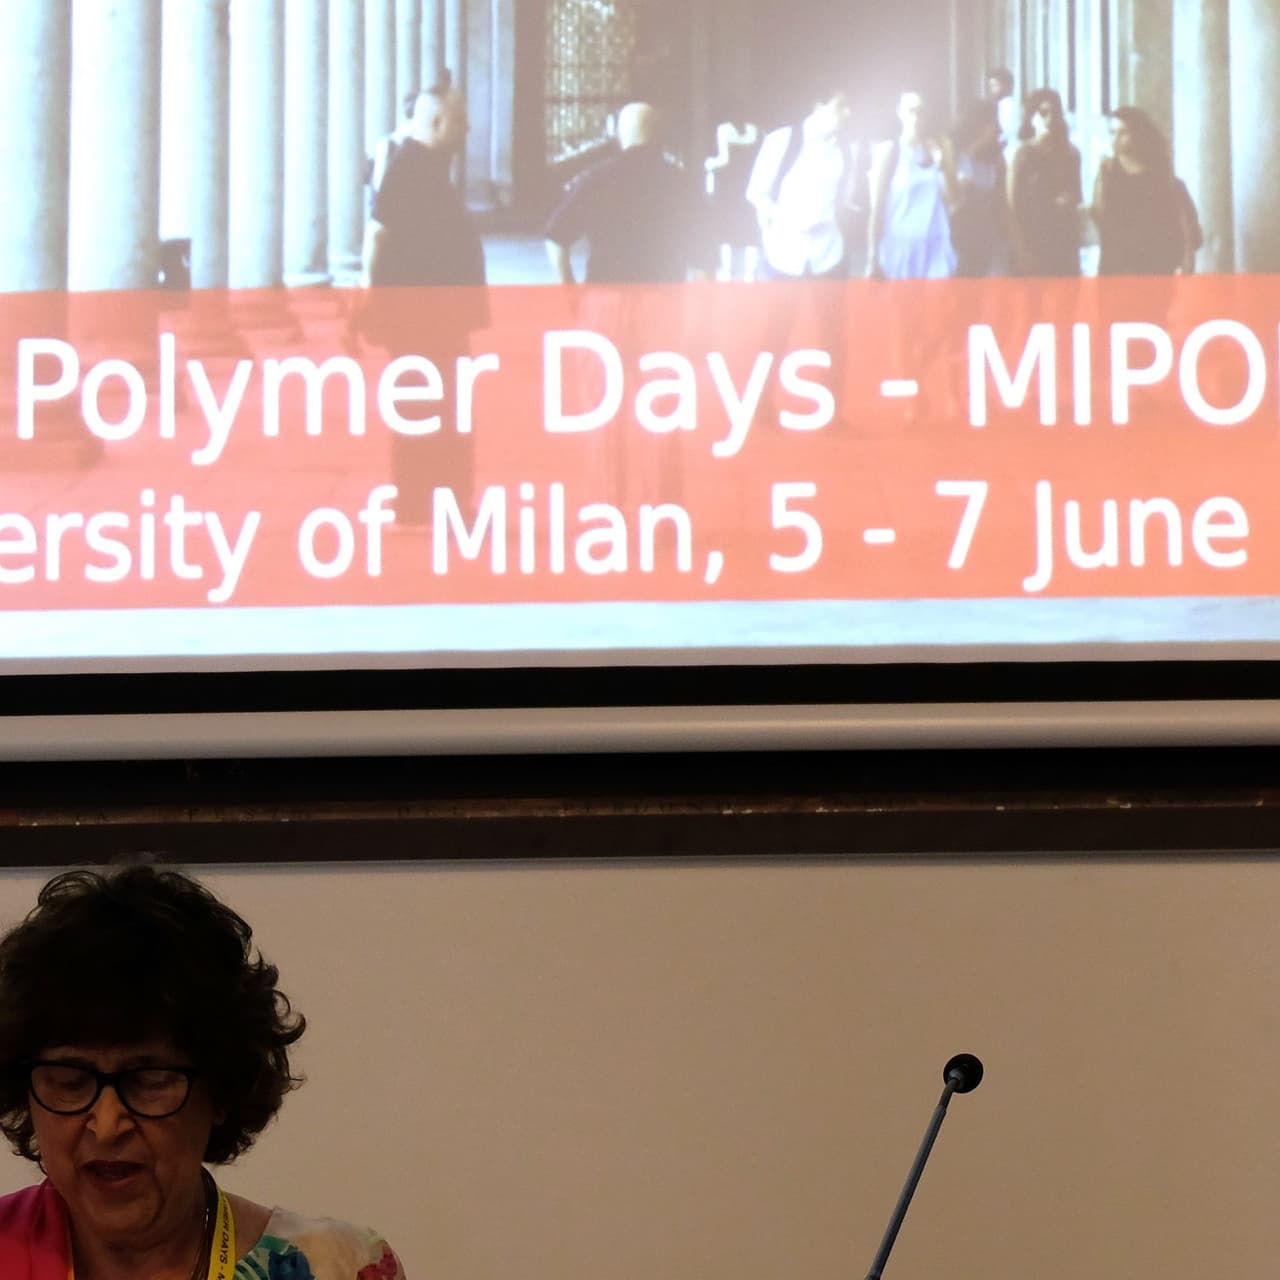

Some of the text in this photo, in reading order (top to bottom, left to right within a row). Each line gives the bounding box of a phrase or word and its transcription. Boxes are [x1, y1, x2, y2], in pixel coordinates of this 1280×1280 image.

[16, 331, 501, 467] Polymer
[542, 328, 836, 459] Days
[879, 378, 919, 398] -
[297, 483, 399, 582] of
[432, 481, 725, 585] Milan,
[768, 481, 824, 574] 5
[862, 527, 897, 545] -
[933, 481, 990, 571] 7
[1021, 477, 1251, 596] June
[219, 1233, 230, 1266] DAYS
